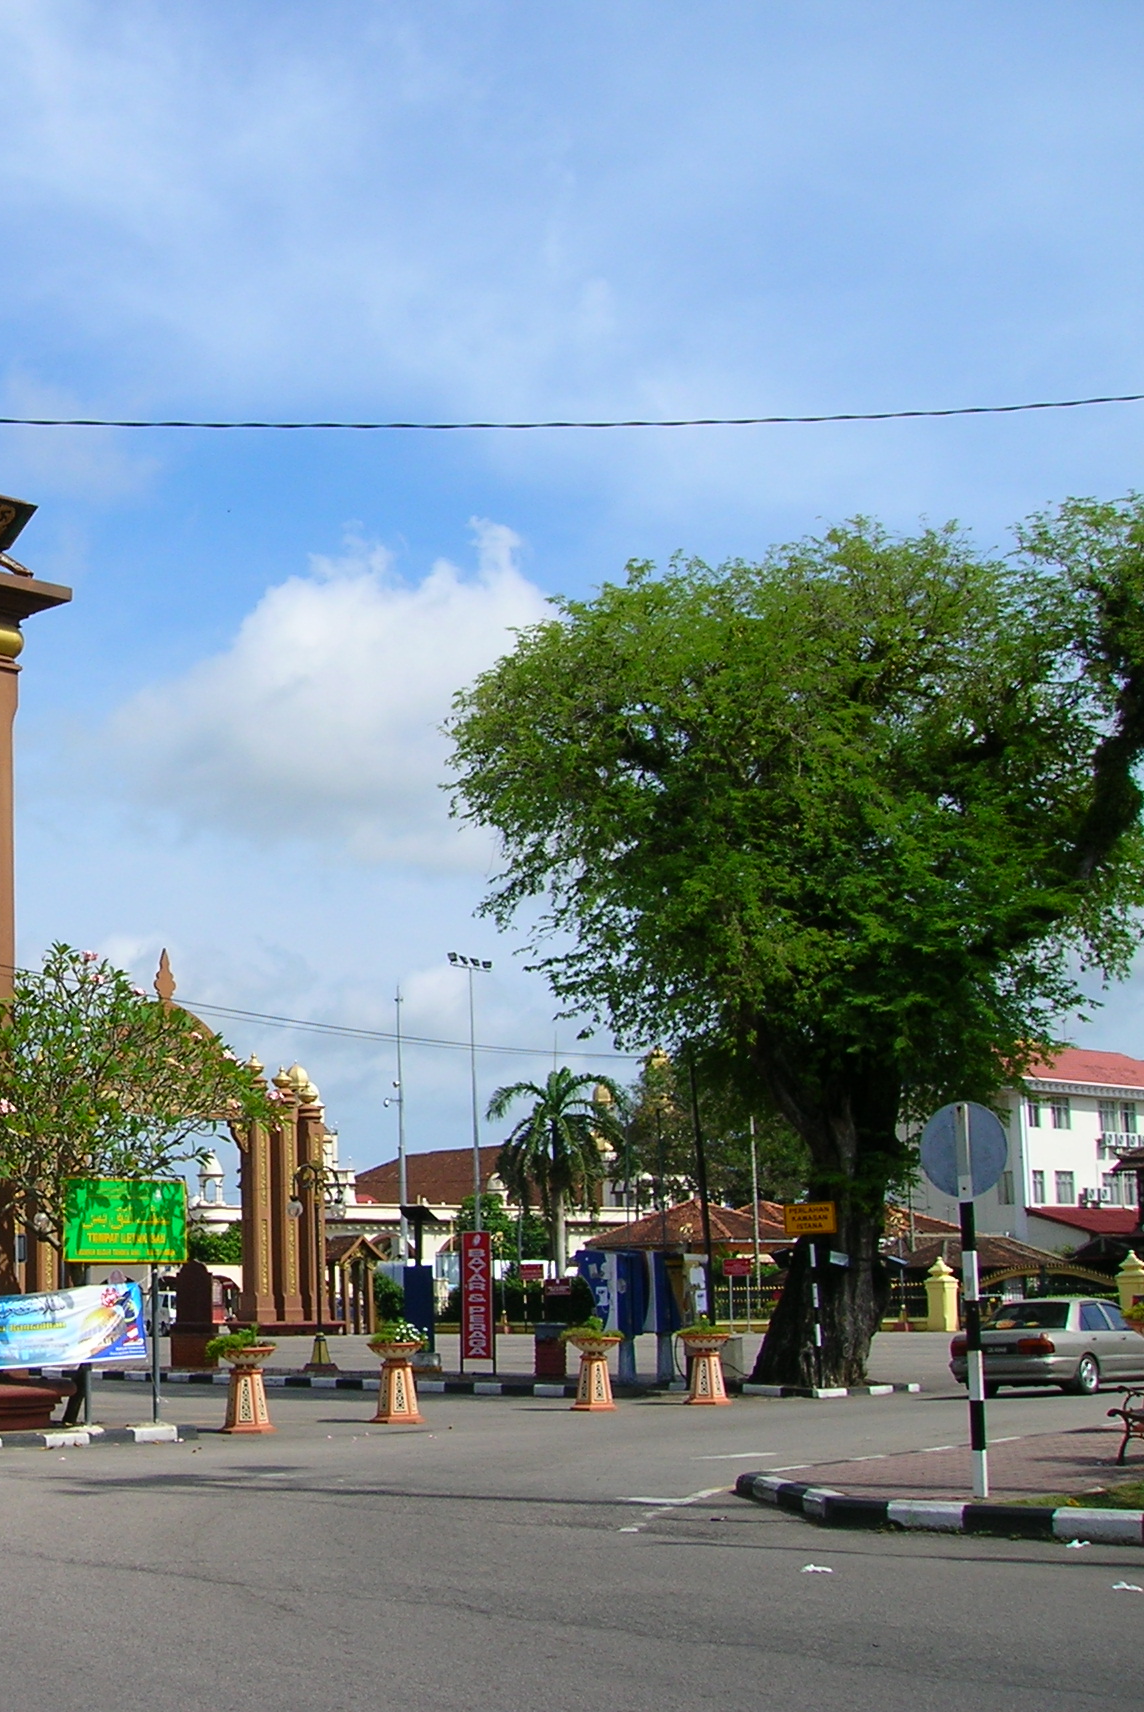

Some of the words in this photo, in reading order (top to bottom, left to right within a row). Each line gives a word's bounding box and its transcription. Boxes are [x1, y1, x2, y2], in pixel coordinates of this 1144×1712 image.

[788, 1206, 829, 1214] PERLAHAN
[467, 1248, 487, 1291] BAYAR
[467, 1293, 486, 1303] &
[9, 1322, 67, 1333] Ramadhan
[467, 1305, 487, 1356] PERAGA
